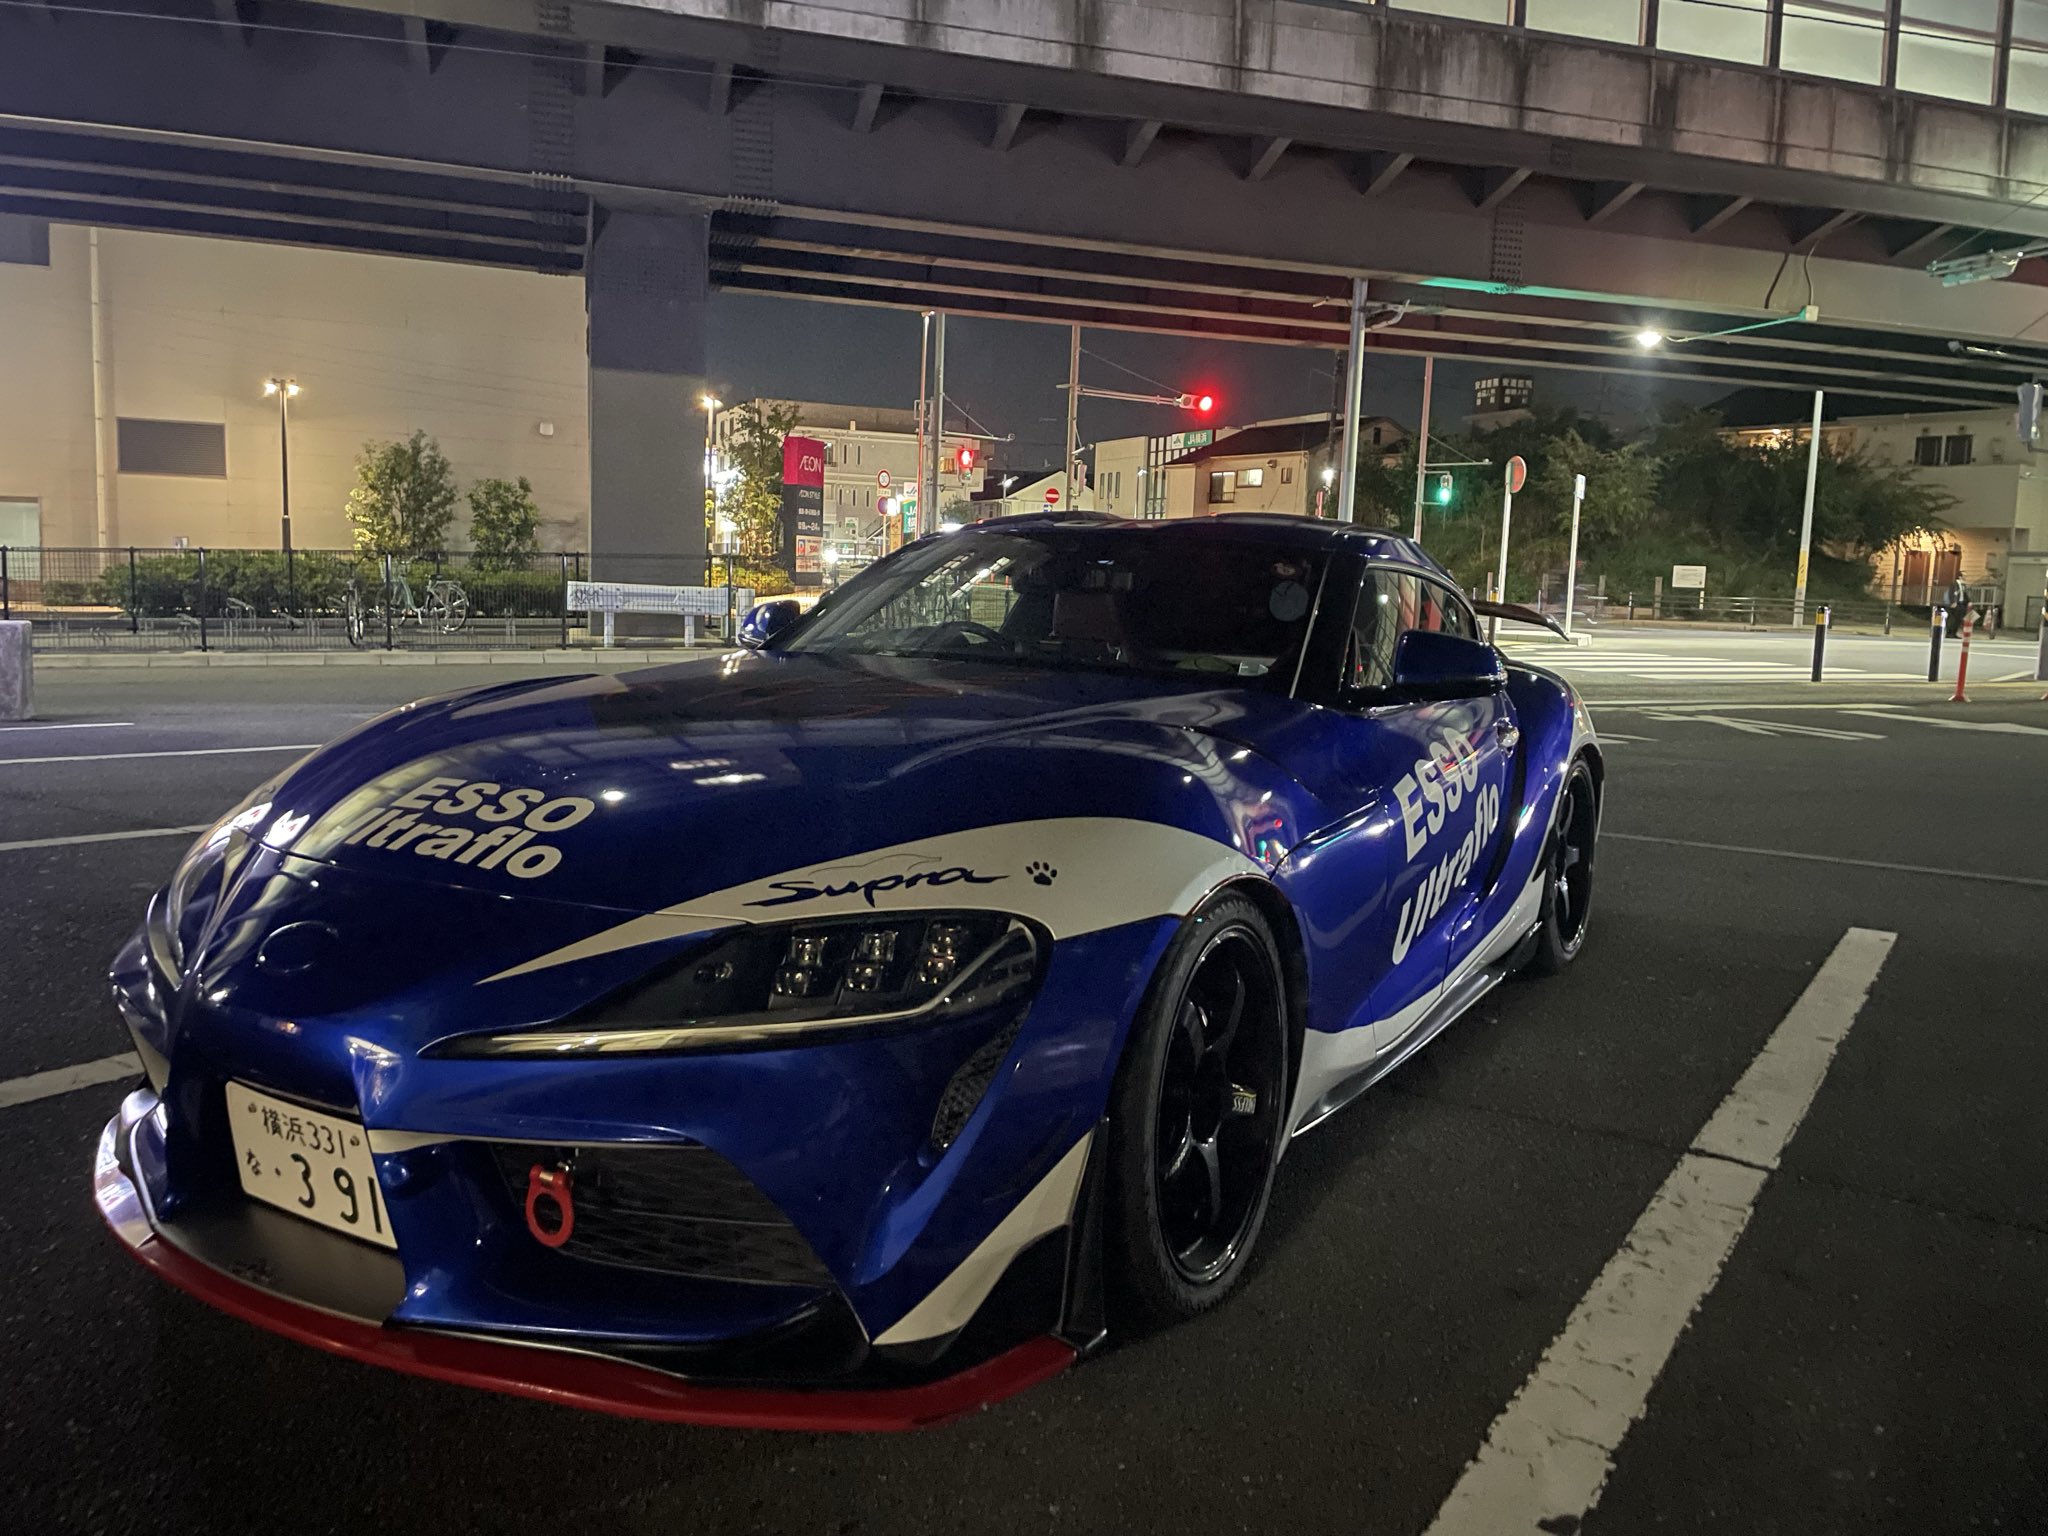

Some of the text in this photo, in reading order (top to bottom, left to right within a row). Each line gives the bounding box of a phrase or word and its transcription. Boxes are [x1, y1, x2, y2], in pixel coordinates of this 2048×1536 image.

[390, 776, 595, 832] ESSO
[1393, 727, 1479, 863] ESSO
[742, 867, 1010, 908] Supra
[1392, 783, 1499, 965] Ultraflo
[306, 1121, 346, 1159] 331
